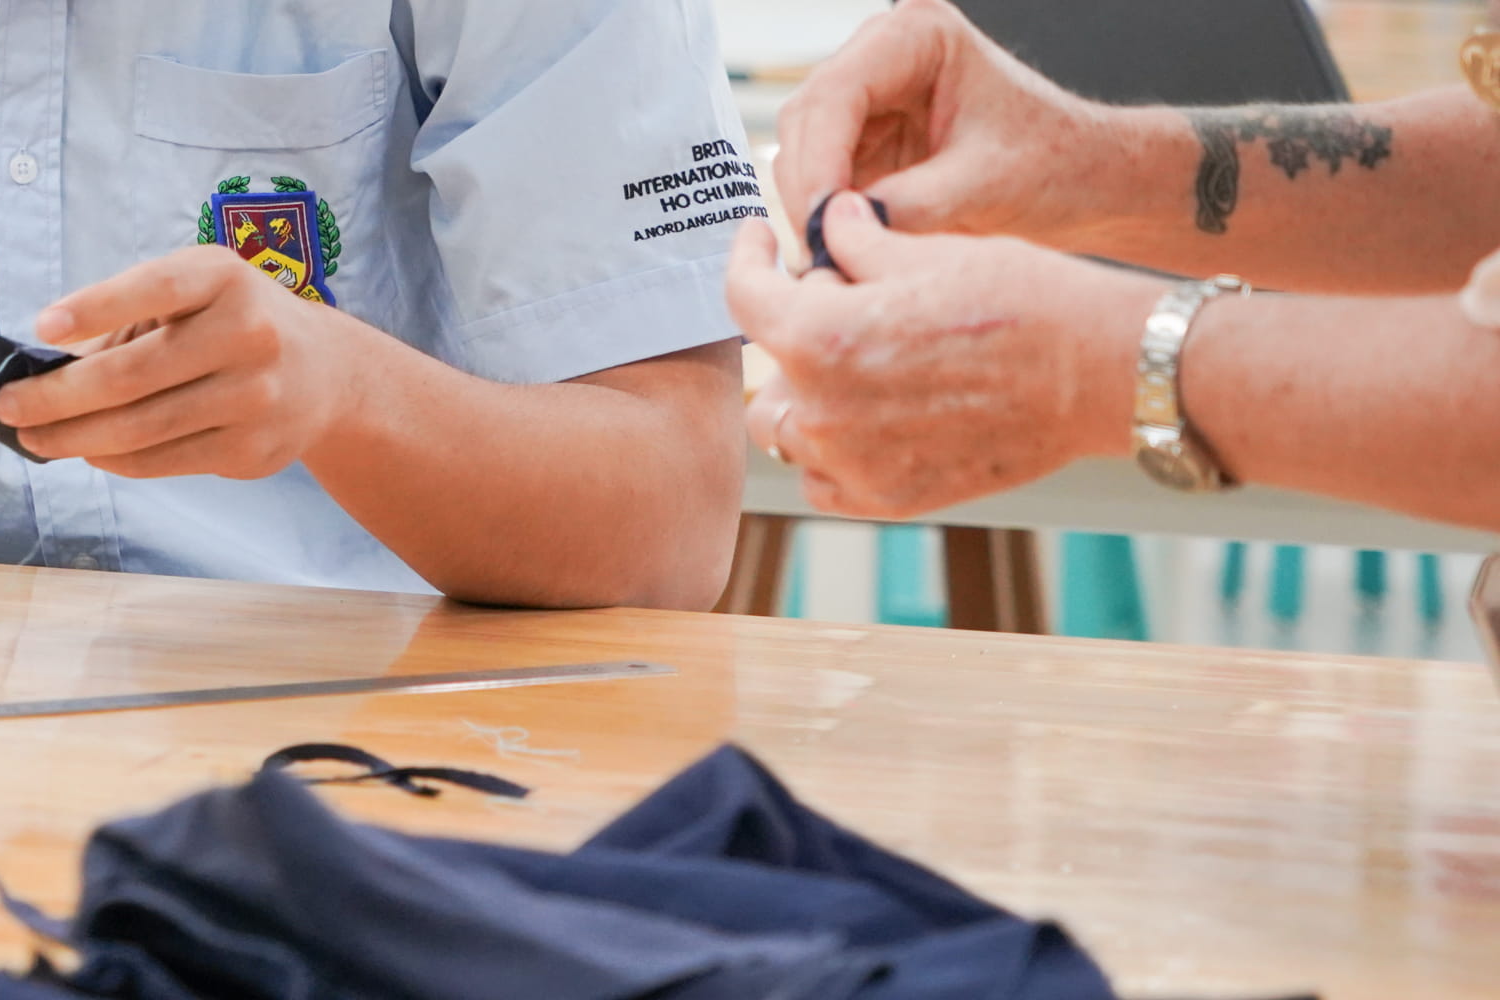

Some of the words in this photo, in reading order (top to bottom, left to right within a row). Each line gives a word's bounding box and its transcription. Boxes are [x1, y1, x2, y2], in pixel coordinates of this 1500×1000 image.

[691, 139, 738, 162] BRIT
[622, 160, 745, 200] INTERNATION
[660, 193, 691, 213] HO
[693, 186, 724, 205] CHI
[644, 221, 685, 238] NORD
[686, 209, 732, 230] ANGLIA
